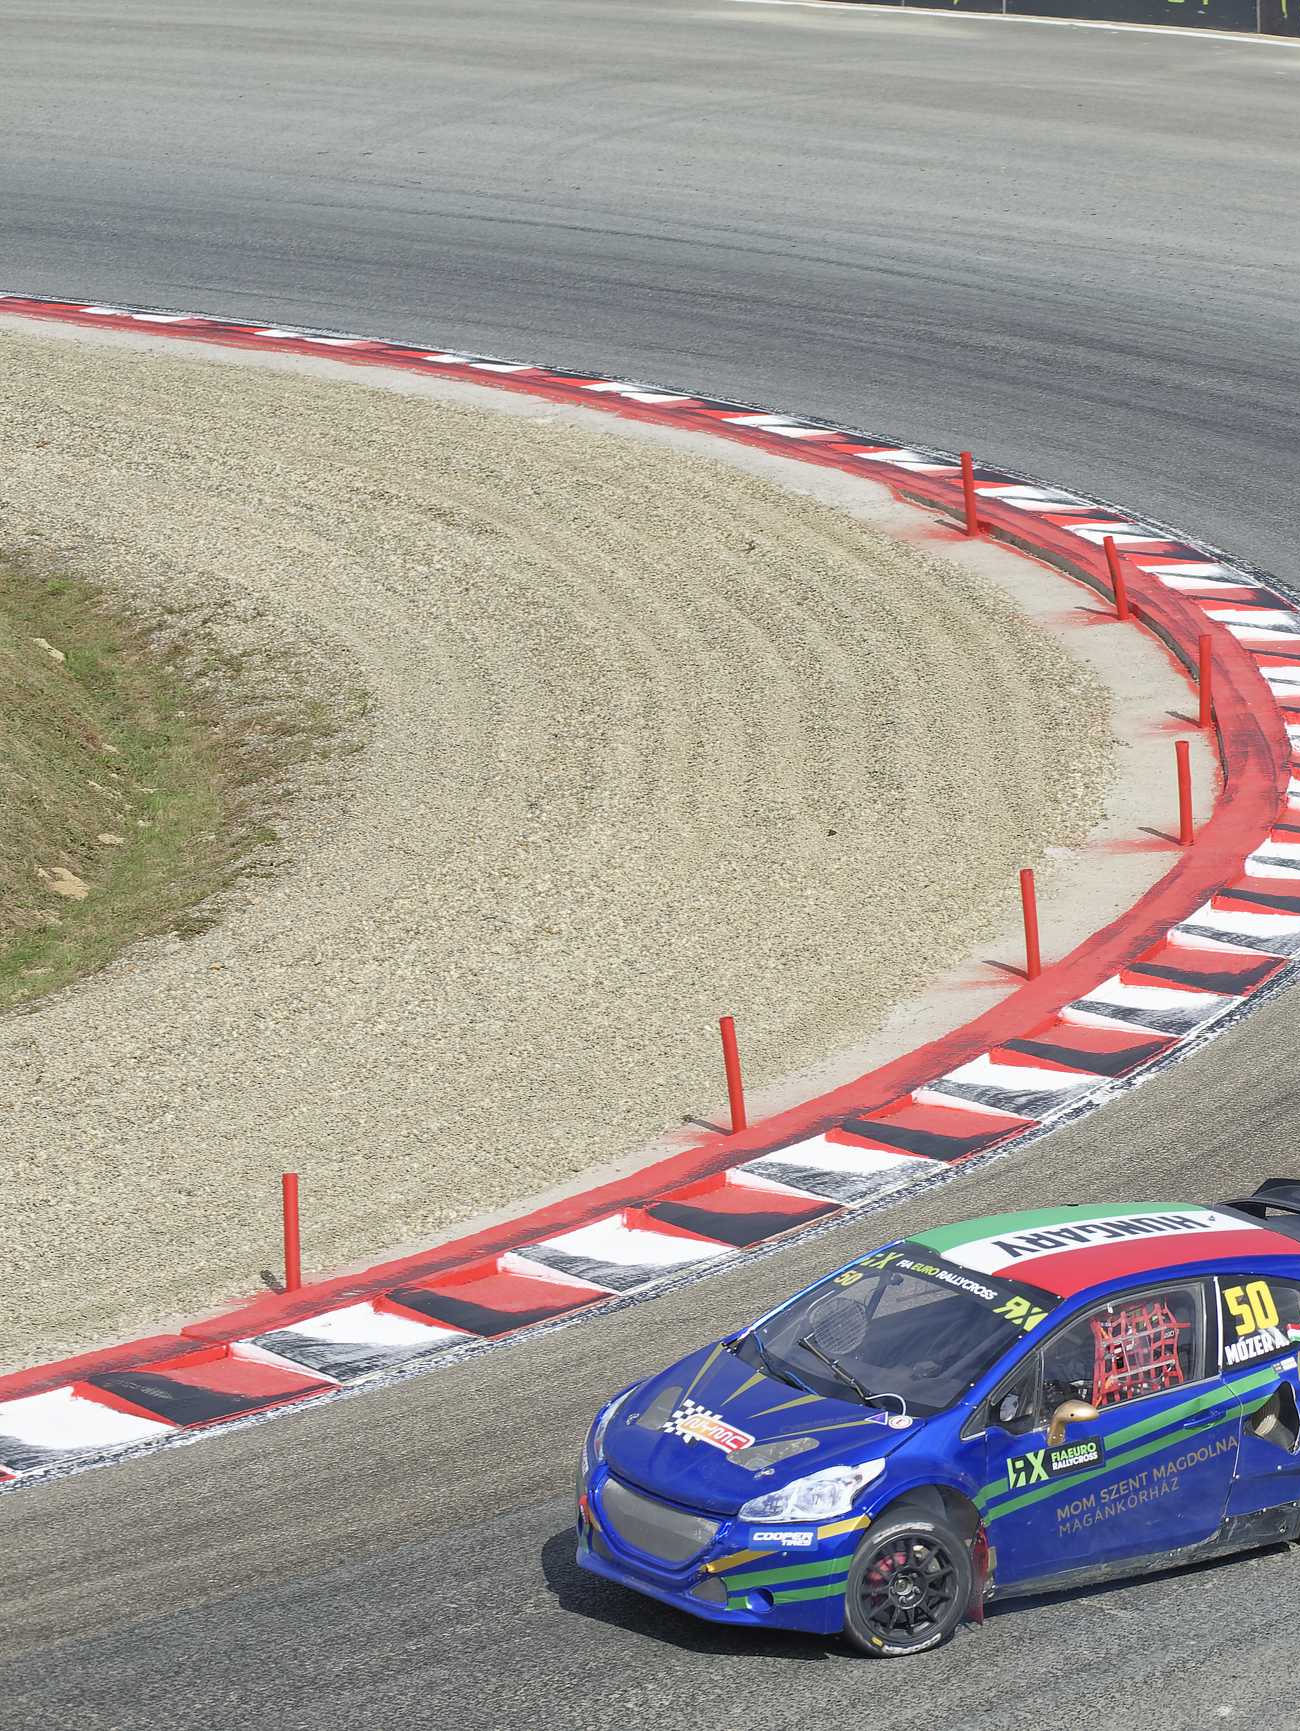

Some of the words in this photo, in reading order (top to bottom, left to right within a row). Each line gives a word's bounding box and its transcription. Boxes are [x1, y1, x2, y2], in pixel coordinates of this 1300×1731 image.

[991, 1214, 1212, 1258] HUNGARY
[833, 1269, 864, 1287] 50
[911, 1262, 941, 1277] EURO
[935, 1270, 999, 1301] RALLYCROSS
[1222, 1280, 1279, 1336] 50
[1051, 1451, 1099, 1471] RALLYCROSS
[1056, 1493, 1096, 1522] MOM
[1100, 1471, 1149, 1504] SZENT
[1152, 1434, 1238, 1482] MAGDOLNA
[752, 1531, 814, 1542] COOPER
